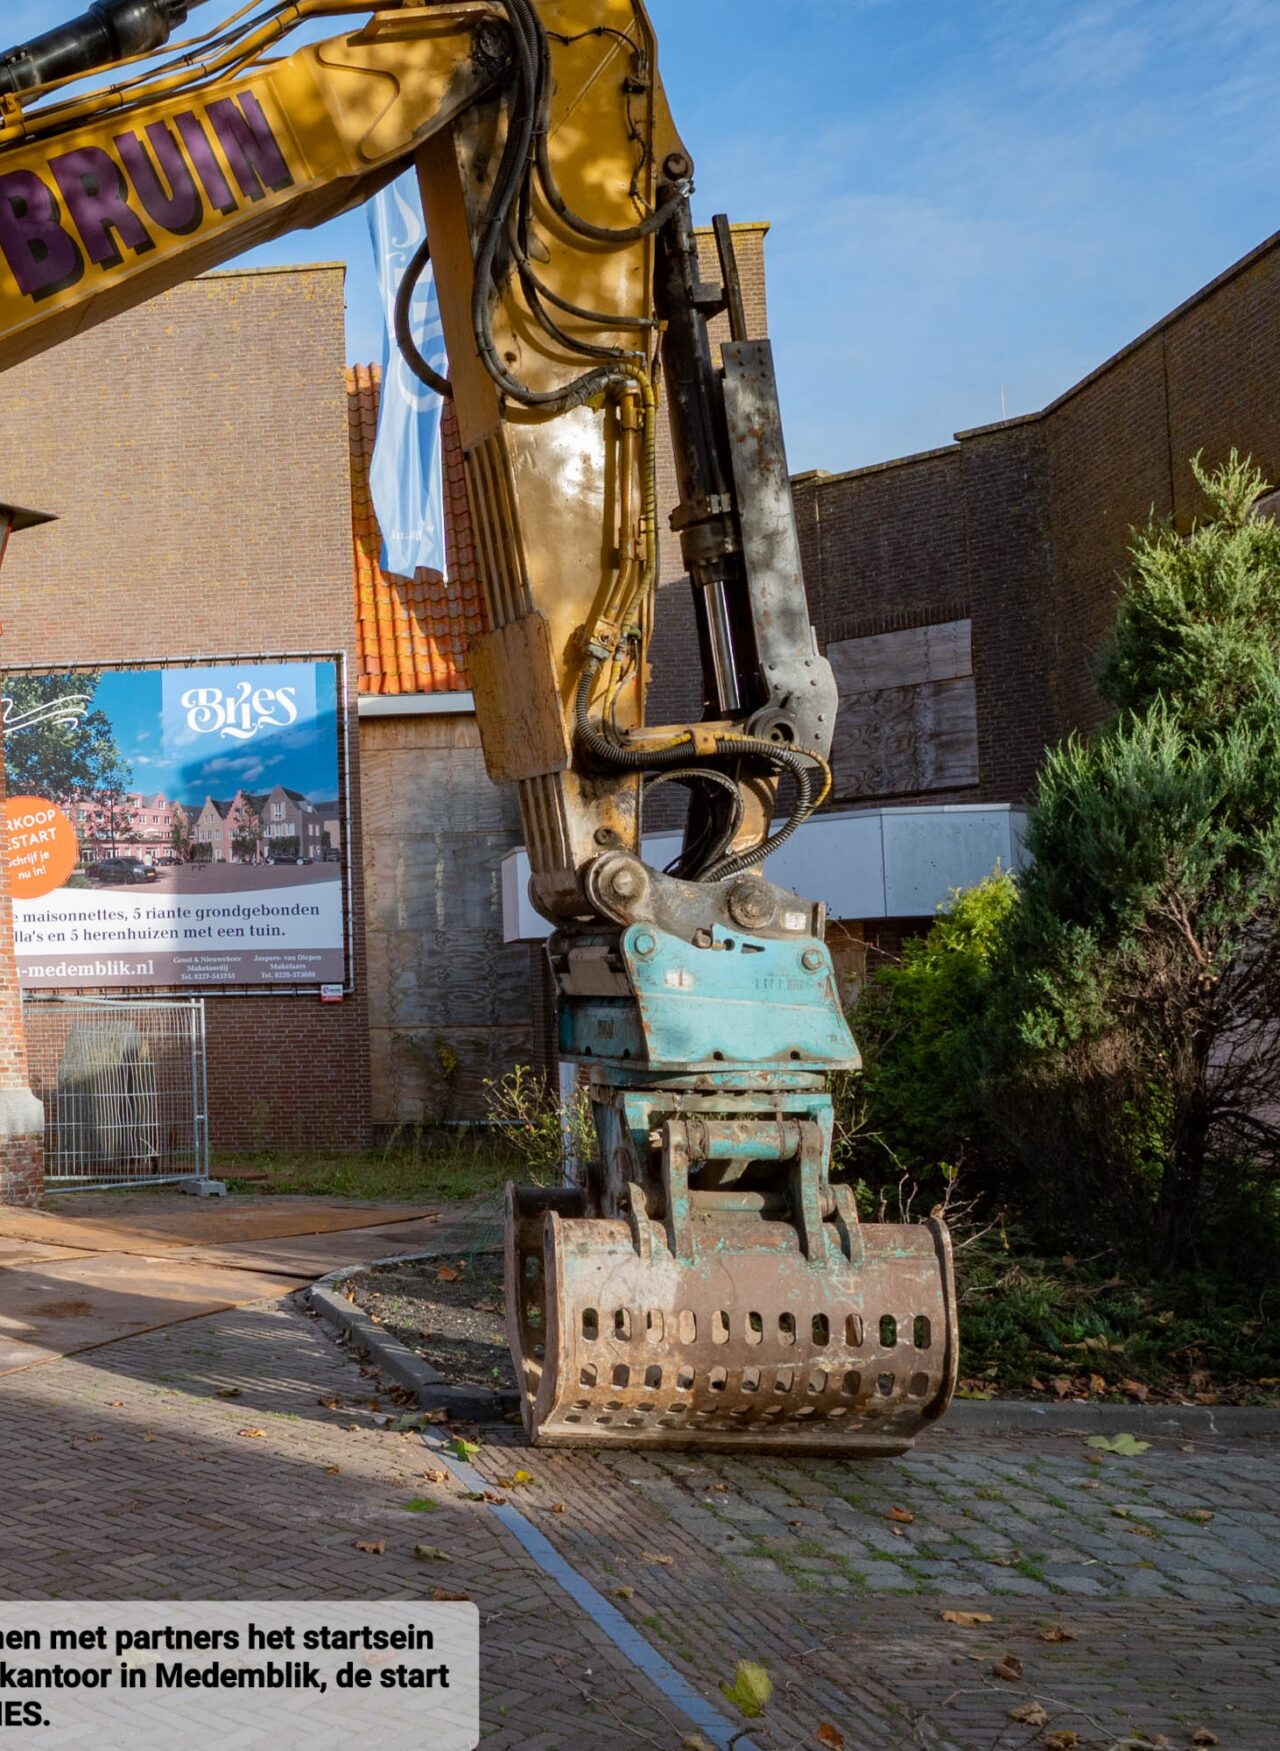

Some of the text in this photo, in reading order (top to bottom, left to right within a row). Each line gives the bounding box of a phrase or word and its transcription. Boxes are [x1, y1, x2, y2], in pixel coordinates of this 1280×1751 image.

[39, 850, 50, 863] je
[17, 864, 46, 880] nu in!
[23, 908, 128, 923] maisonnettes,
[133, 907, 141, 920] 5
[146, 906, 191, 920] riante
[195, 903, 320, 921] grondgebonden
[48, 932, 65, 942] en
[70, 929, 78, 941] 5
[83, 927, 178, 941] herenhuizen
[184, 926, 212, 939] met
[217, 926, 245, 938] een
[250, 924, 286, 937] tuin.
